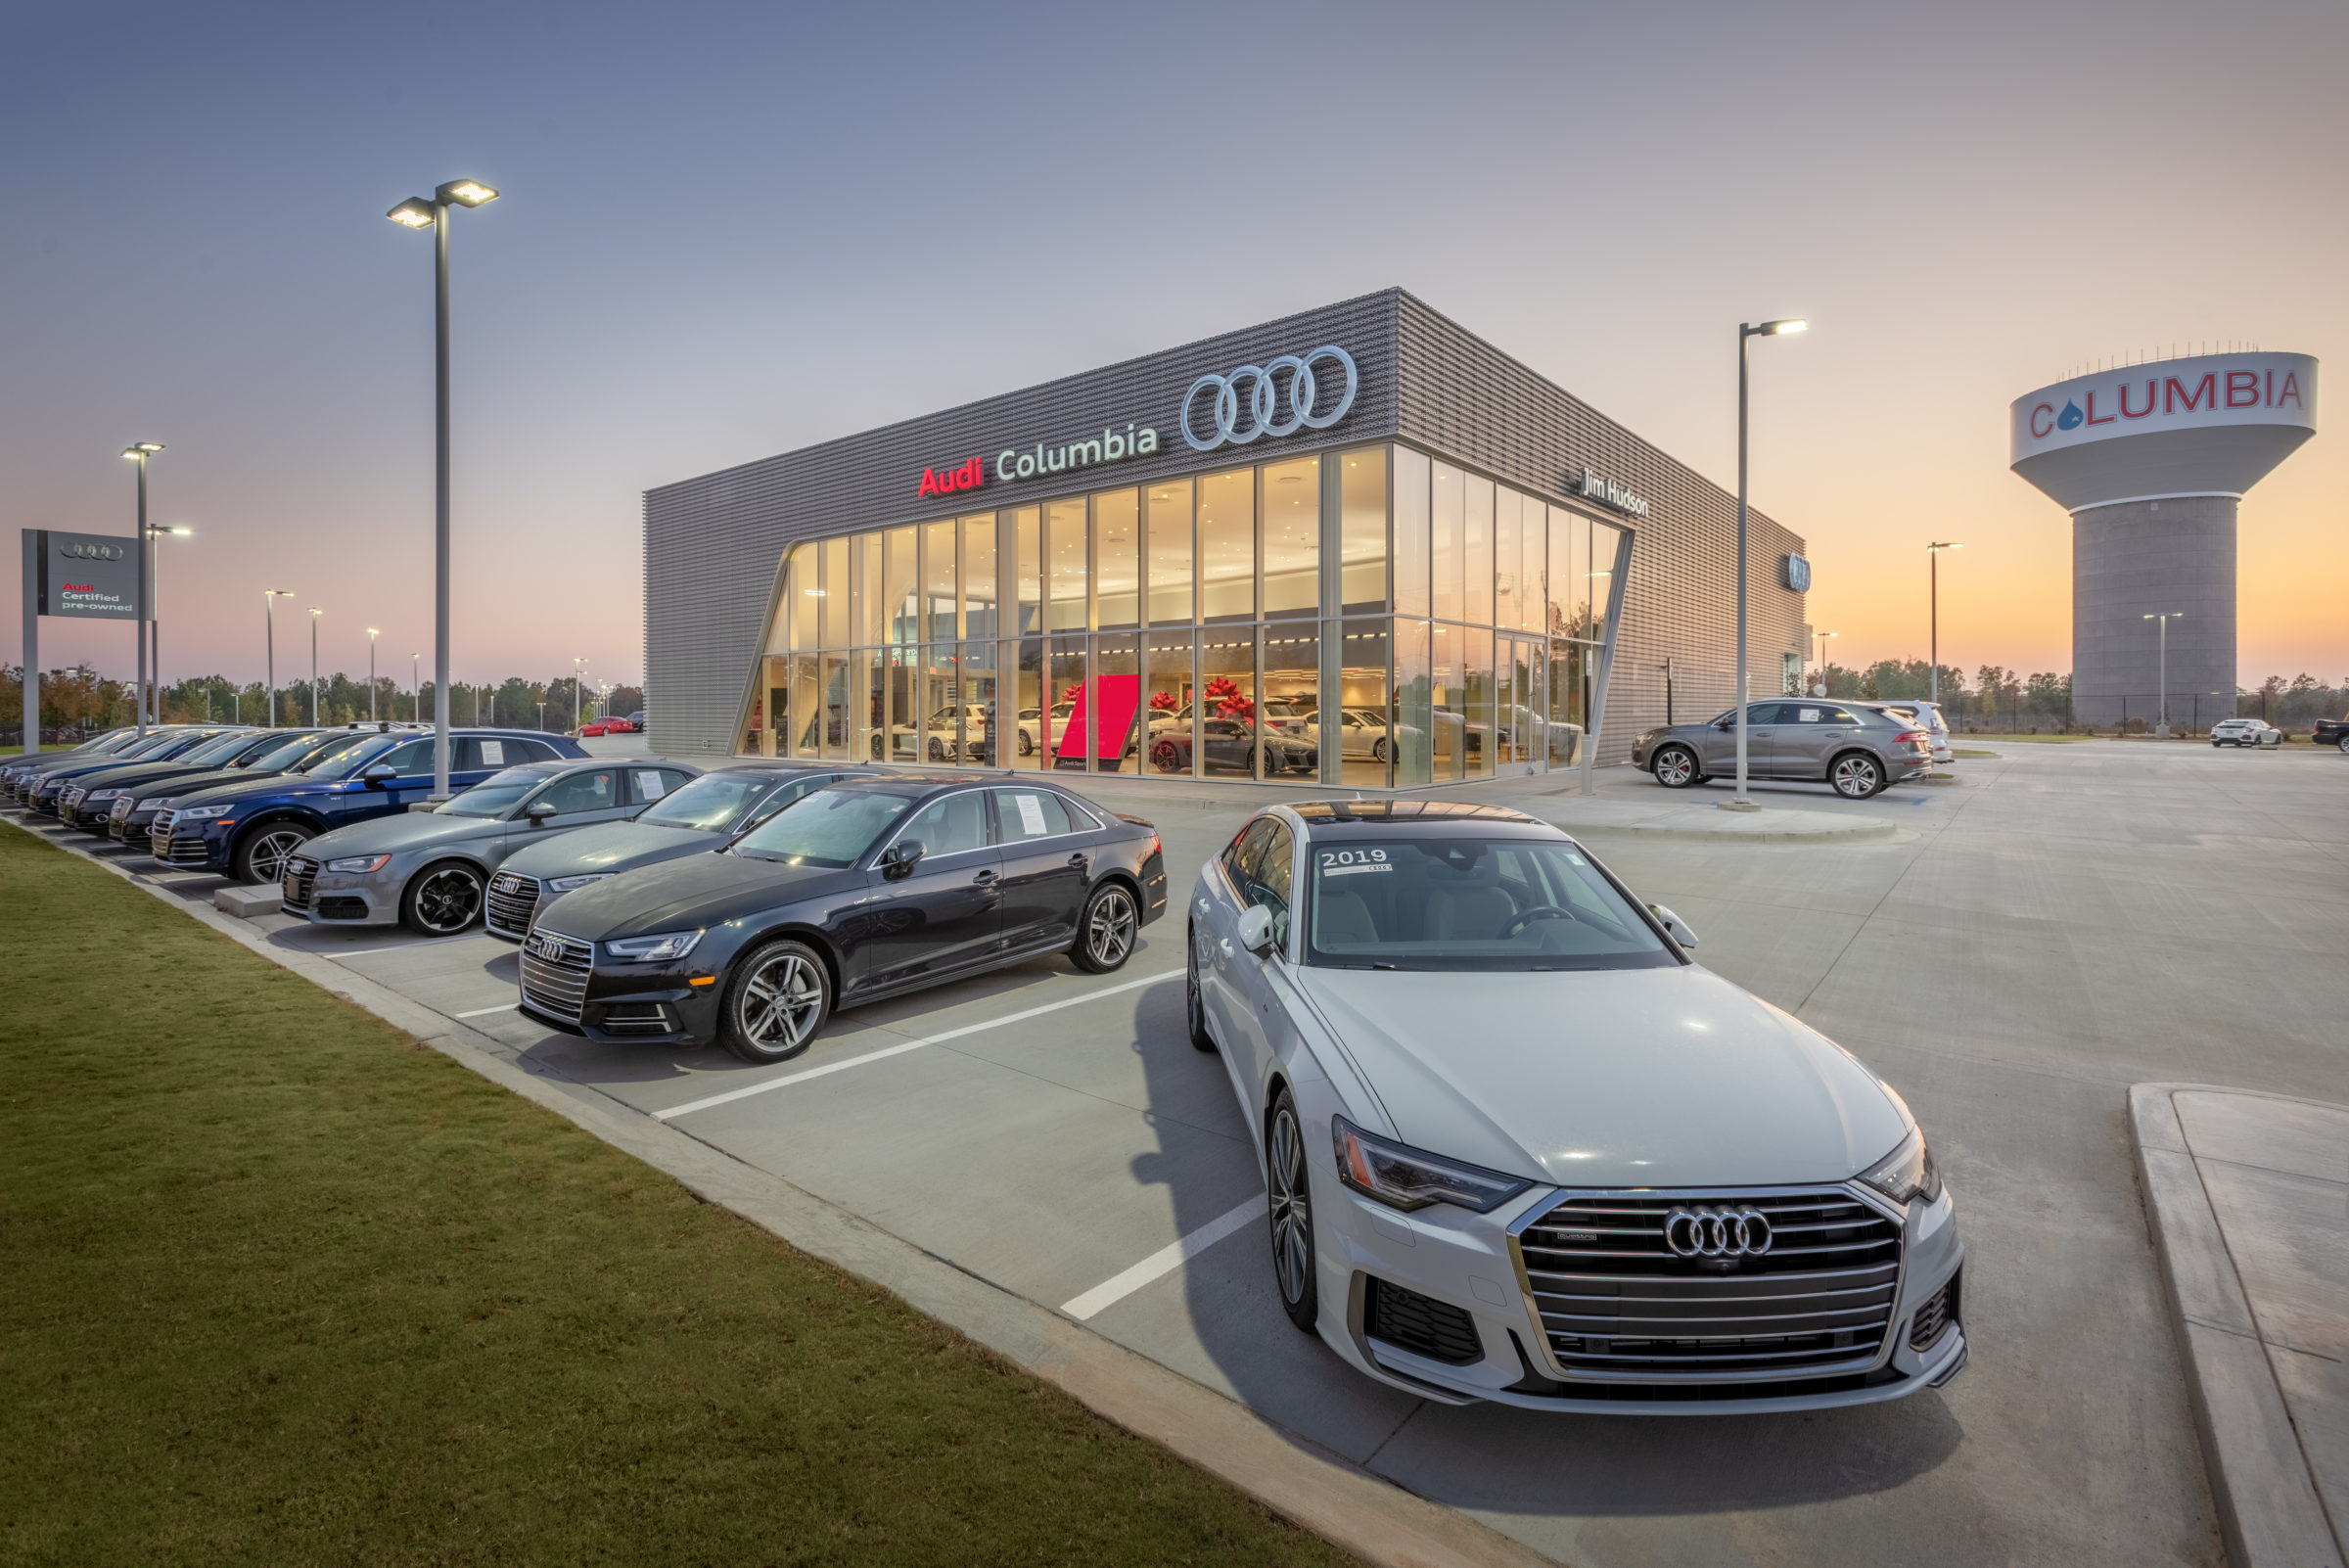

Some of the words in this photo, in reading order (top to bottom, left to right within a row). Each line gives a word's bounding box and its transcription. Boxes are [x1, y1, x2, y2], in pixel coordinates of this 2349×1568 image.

[918, 456, 982, 497] Audi
[996, 424, 1158, 481] Columbia
[1584, 467, 1605, 498] Jim
[1607, 478, 1649, 518] Hudson
[63, 582, 94, 592] Audi
[62, 592, 119, 602] Certified
[62, 603, 133, 612] pre-owned
[1321, 849, 1387, 867] 2019
